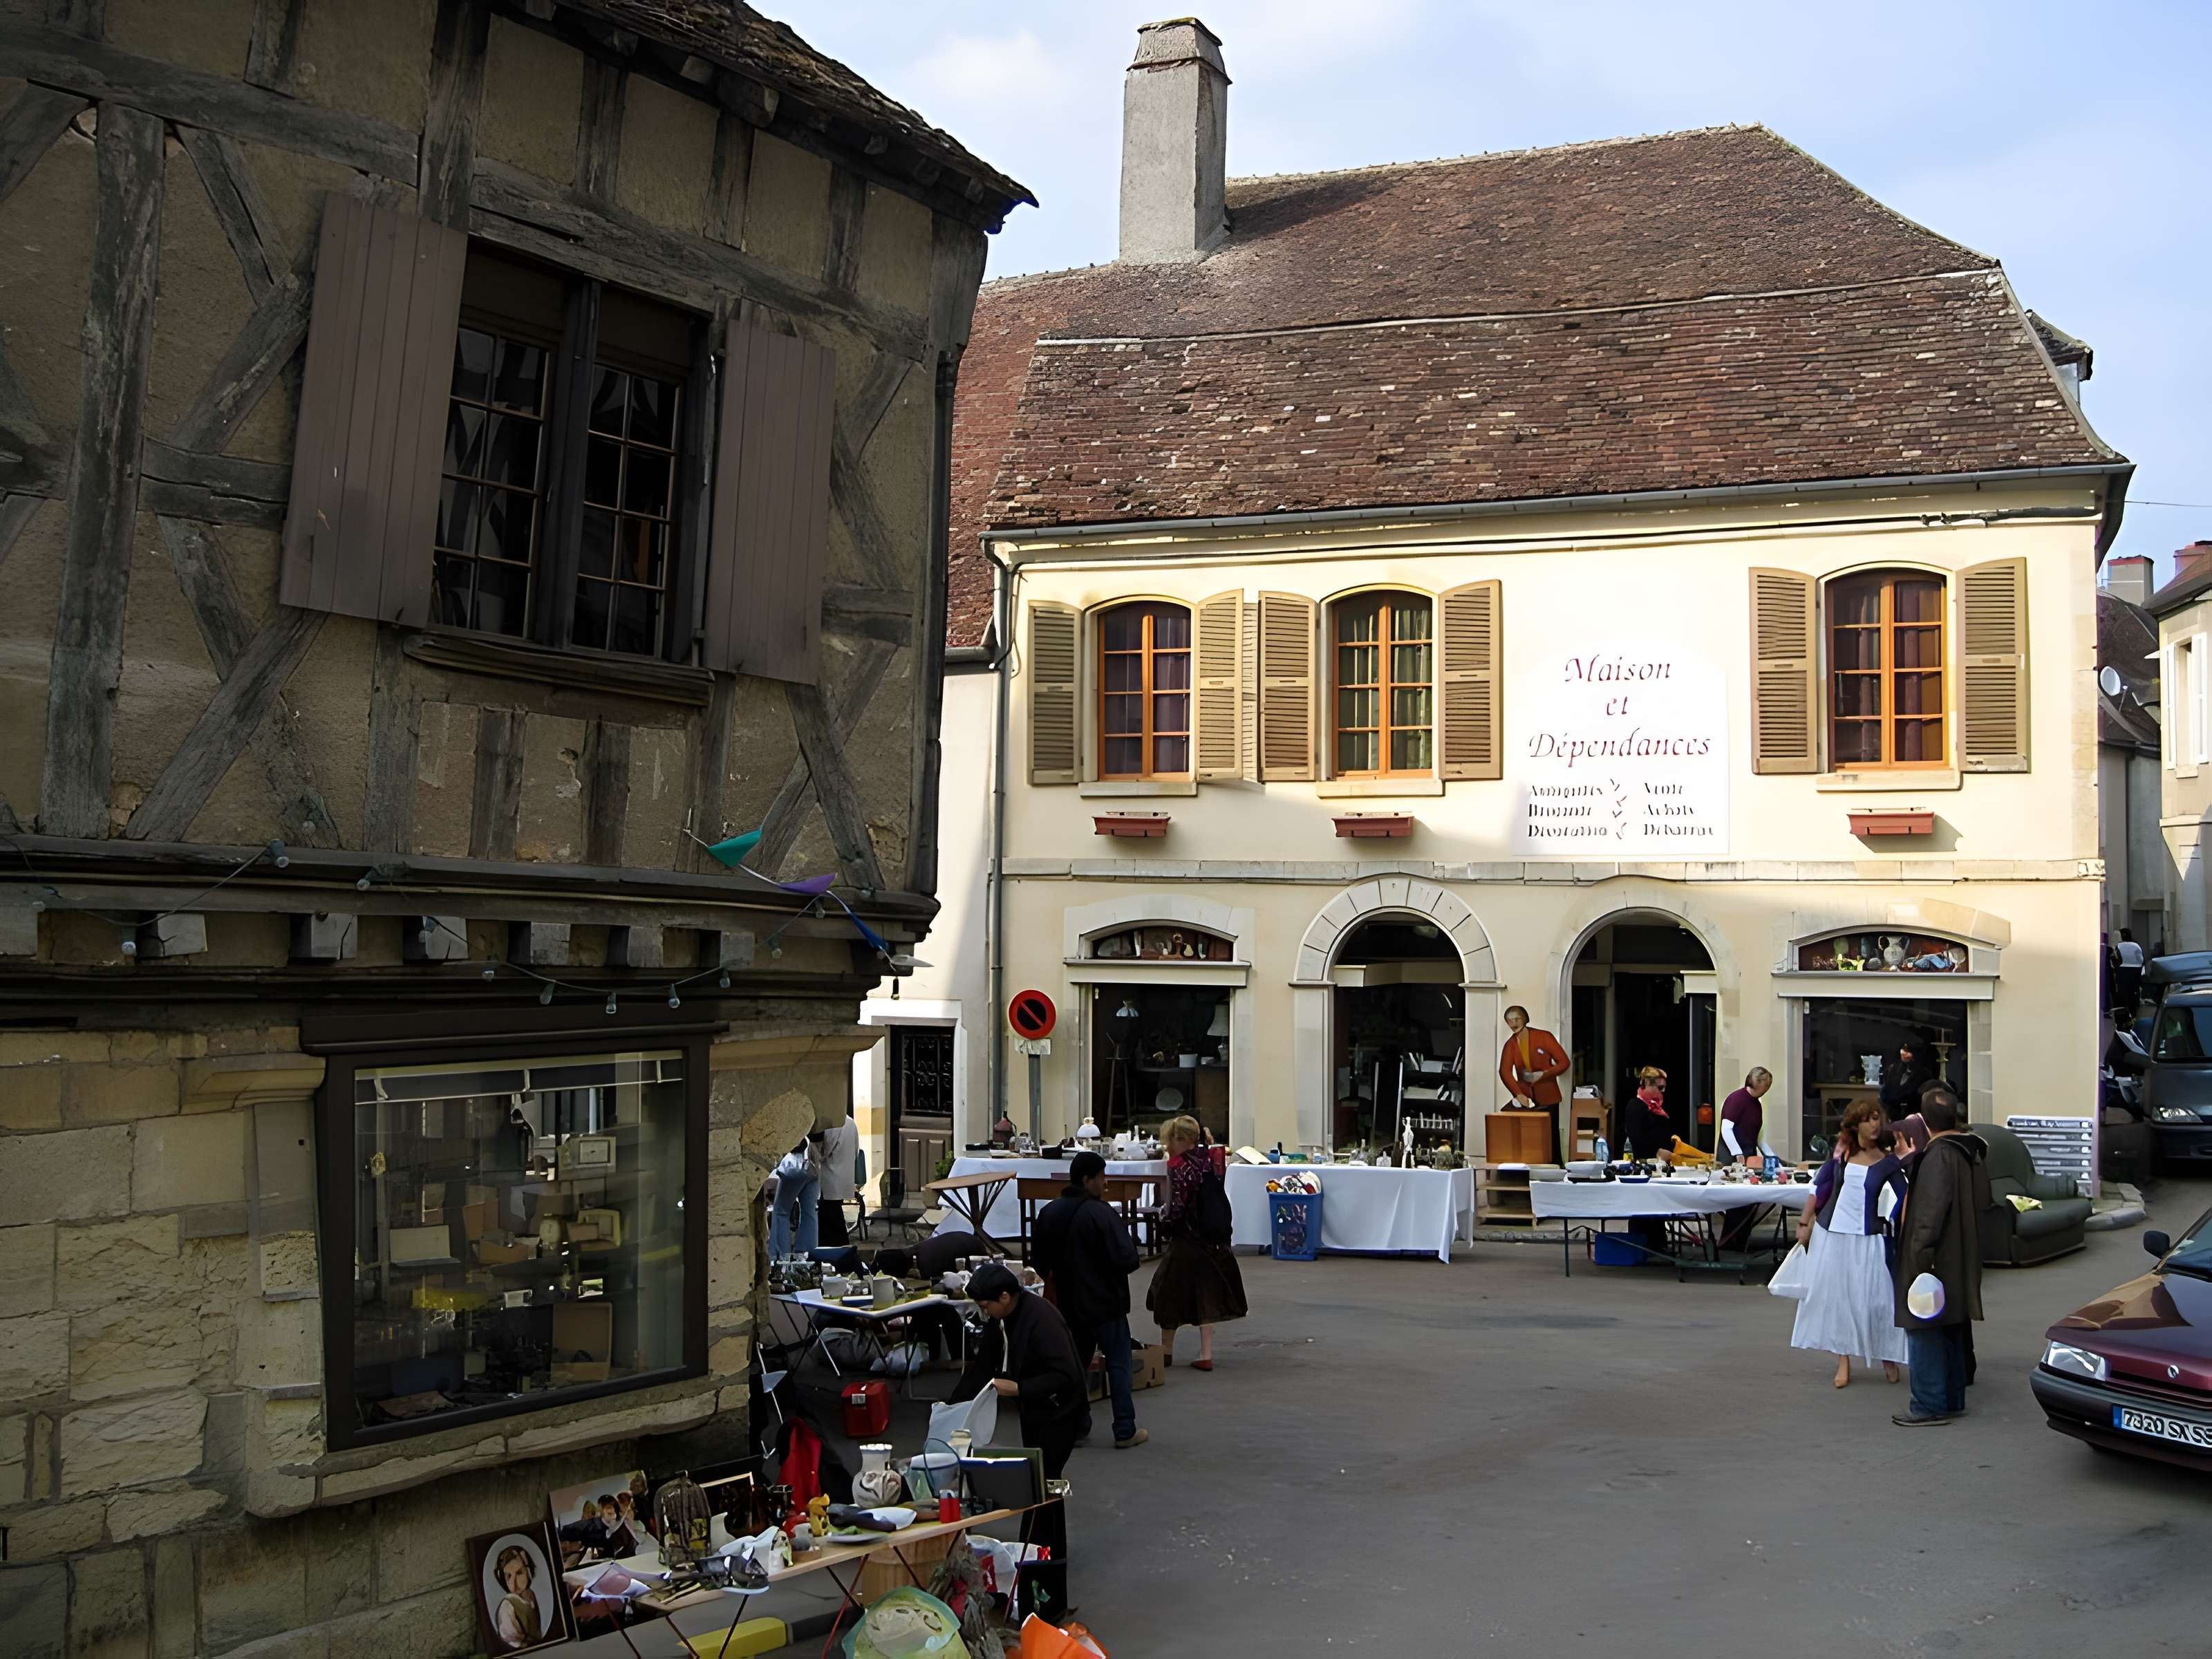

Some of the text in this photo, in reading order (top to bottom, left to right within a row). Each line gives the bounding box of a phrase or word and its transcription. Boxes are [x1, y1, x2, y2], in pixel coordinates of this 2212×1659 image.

[1564, 653, 1671, 682] Maison
[1606, 696, 1628, 716] et
[1528, 727, 1711, 768] Dépendances
